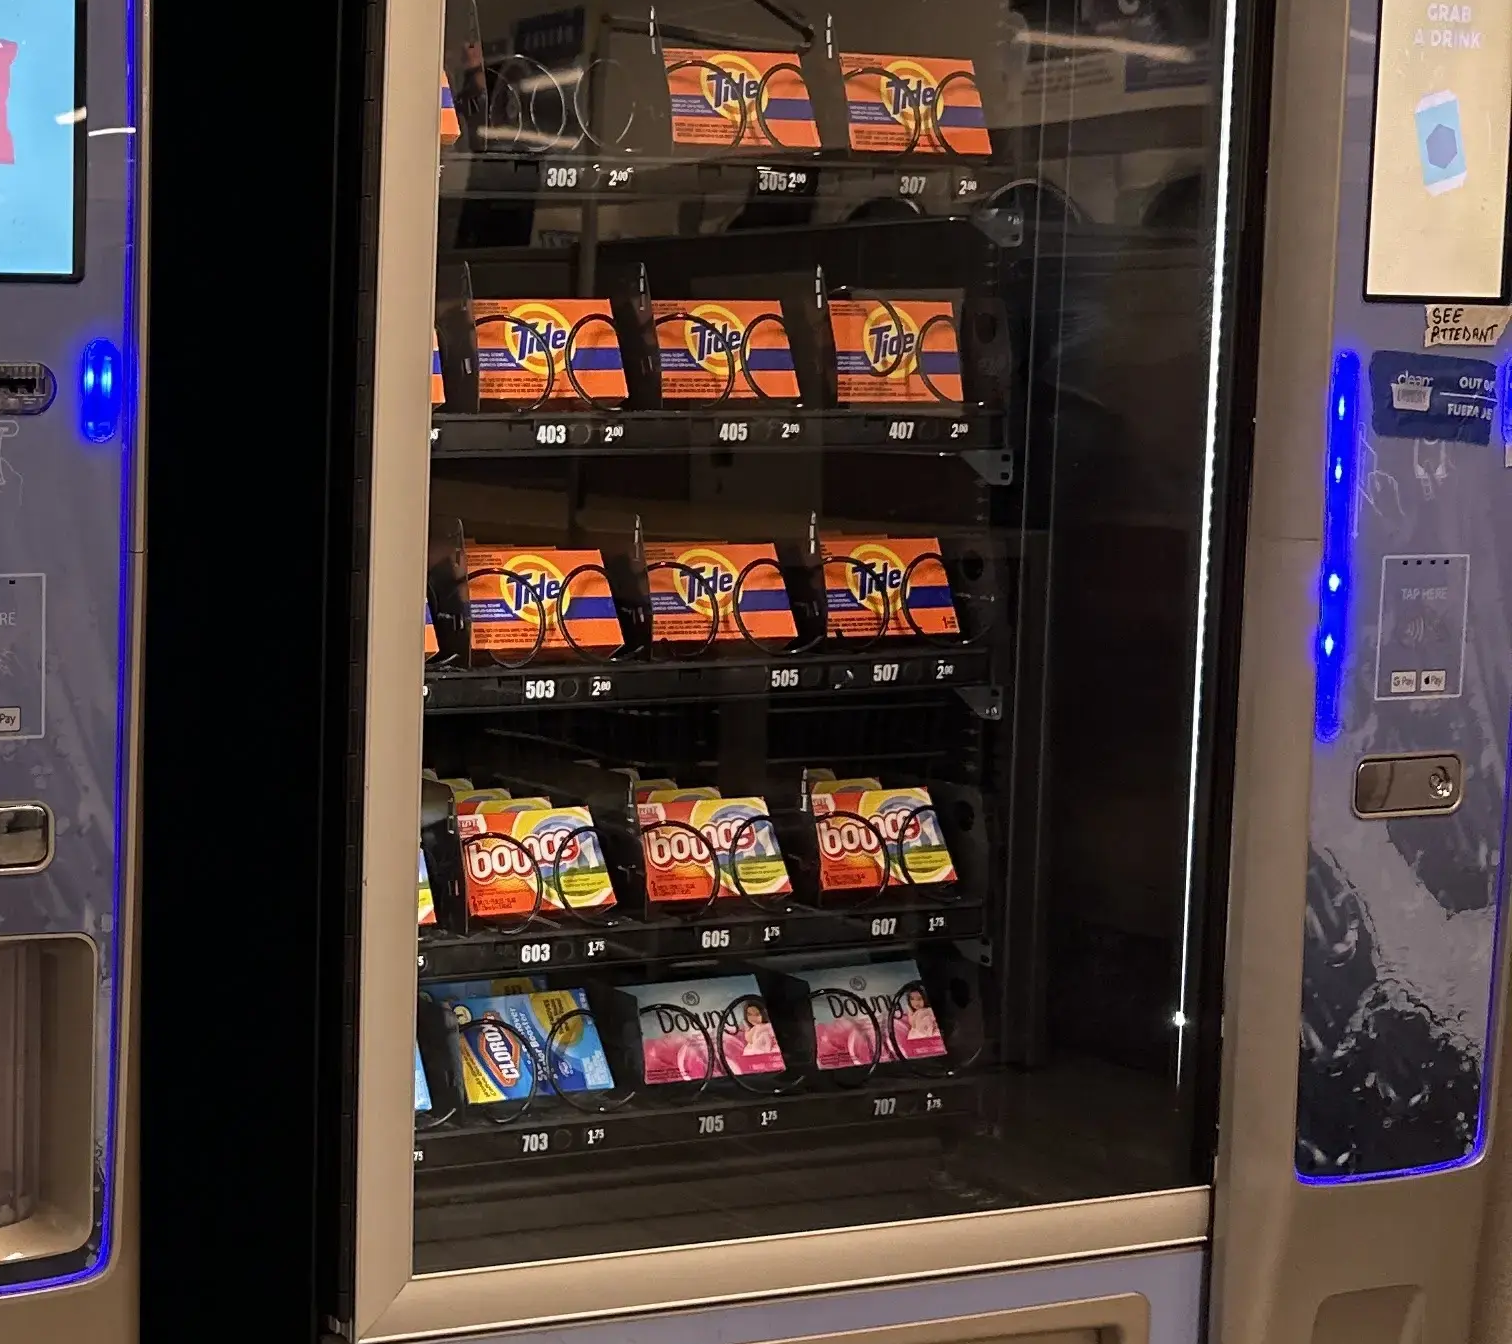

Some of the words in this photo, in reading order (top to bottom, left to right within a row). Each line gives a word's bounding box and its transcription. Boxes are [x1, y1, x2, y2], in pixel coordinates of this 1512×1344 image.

[1427, 2, 1472, 24] GRAB
[1430, 29, 1482, 49] DRINK
[706, 71, 759, 109] Tide
[547, 167, 578, 187] 303
[758, 171, 787, 191] 305
[900, 176, 927, 195] 307
[1433, 308, 1464, 325] SEE
[511, 321, 567, 361] Tide
[691, 323, 741, 361] Tide
[869, 325, 915, 364] Tide
[1459, 376, 1482, 390] OUT
[537, 425, 566, 444] 403
[604, 426, 624, 442] 2.00
[719, 422, 748, 441] 405
[781, 423, 800, 438] 2.00
[889, 422, 915, 439] 407
[951, 424, 969, 438] 2.00
[506, 572, 561, 611] Tide
[679, 565, 734, 604] Tide
[852, 562, 902, 601] Tide
[1401, 588, 1420, 601] TAP
[1421, 587, 1448, 599] HERE
[771, 668, 799, 687] 505
[873, 664, 900, 681] 507
[525, 680, 555, 699] 503
[592, 682, 612, 697] 2.00
[0, 713, 17, 726] Pay
[647, 818, 756, 866] bounce
[818, 809, 921, 856] bounce
[468, 828, 579, 879] bounce
[871, 918, 897, 936] 607
[701, 930, 730, 949] 605
[763, 927, 780, 942] 1.75
[521, 944, 550, 963] 603
[587, 940, 605, 956] 1.75
[873, 1098, 896, 1116] 707
[698, 1115, 724, 1134] 705
[522, 1133, 549, 1152] 703
